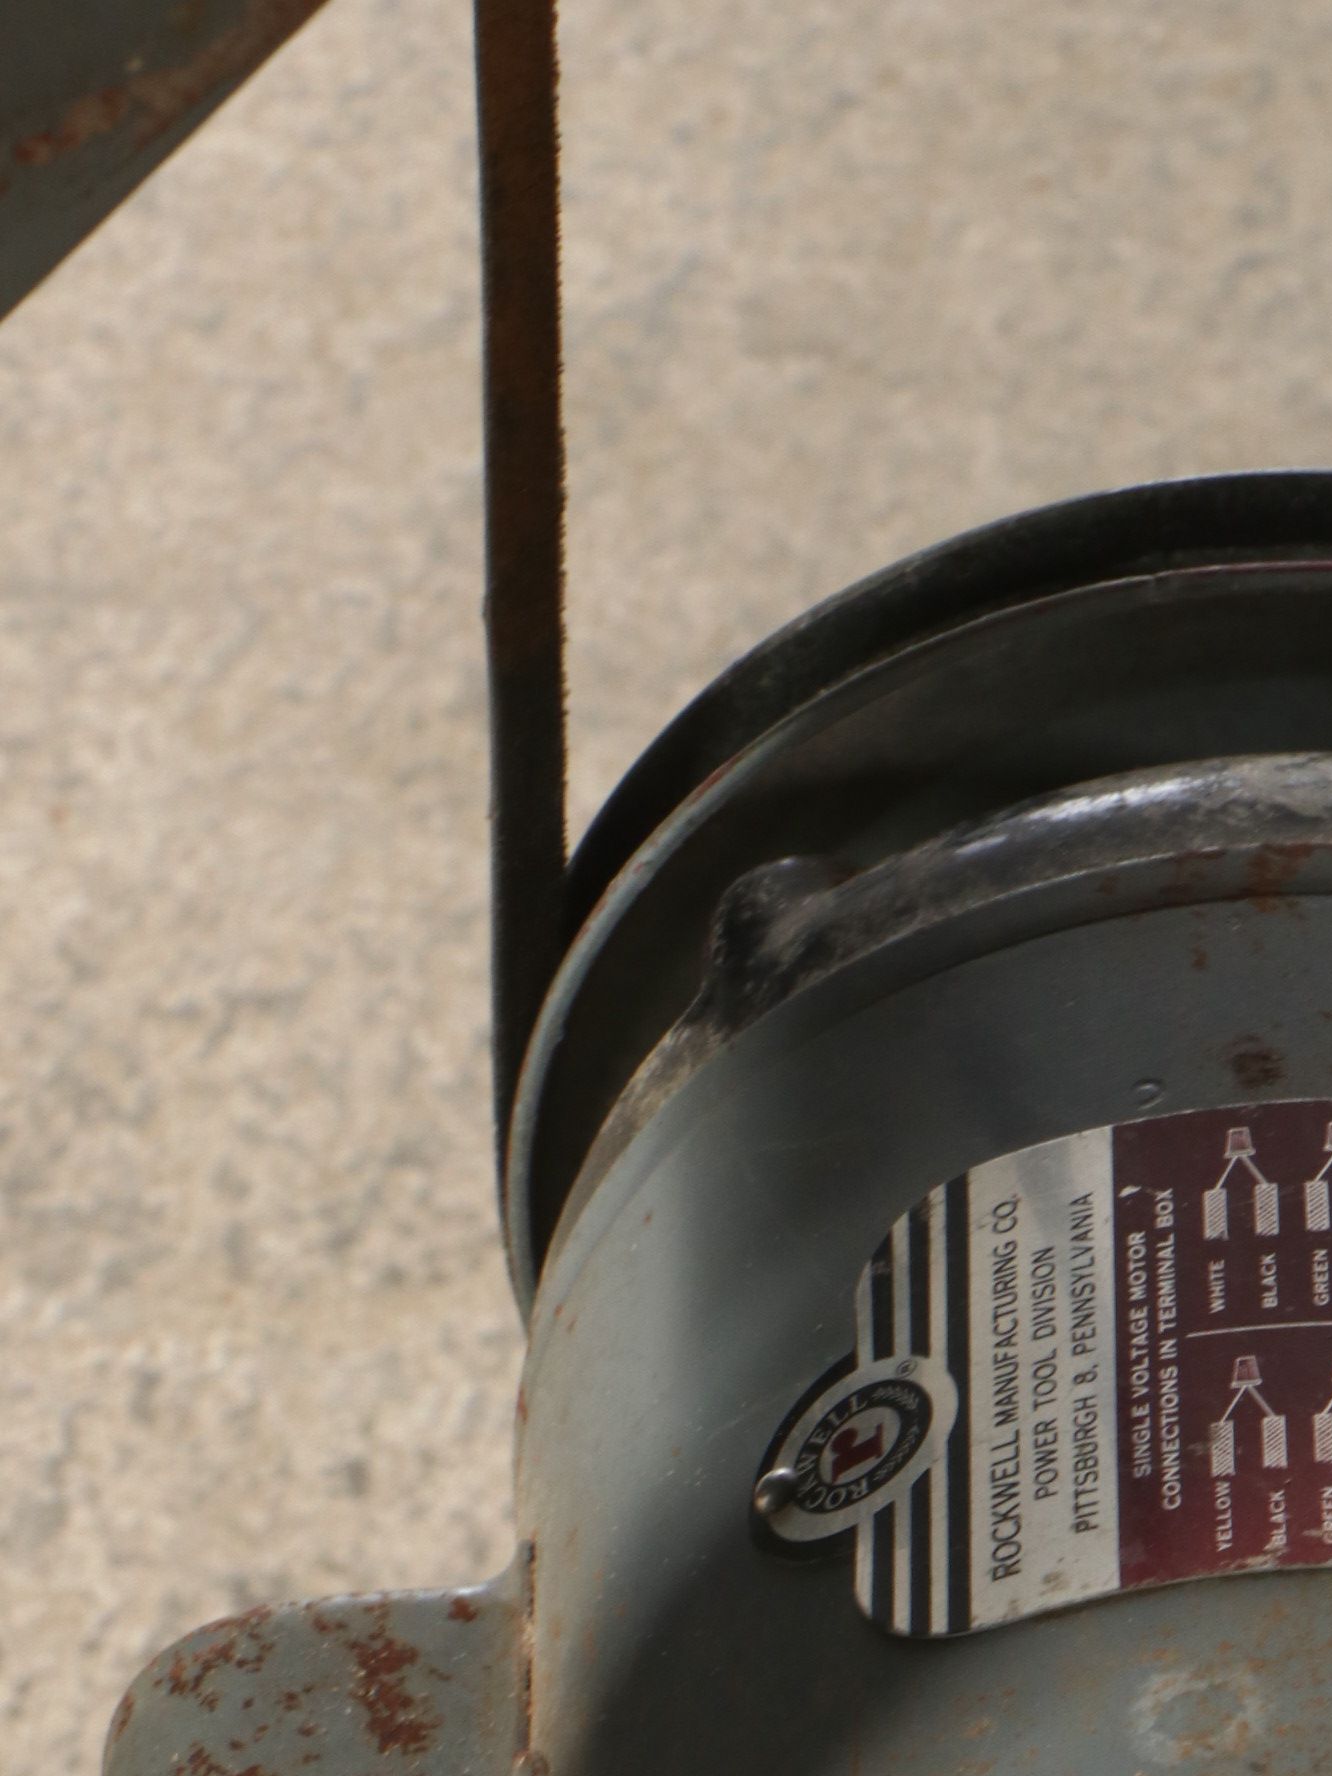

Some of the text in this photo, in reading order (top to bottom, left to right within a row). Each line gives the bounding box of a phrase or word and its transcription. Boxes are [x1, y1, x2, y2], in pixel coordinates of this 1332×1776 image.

[992, 1240, 1019, 1428] MANUFACTURING
[1069, 1192, 1096, 1356] PENNSYLVANIA
[1208, 1259, 1225, 1313] WHITE
[1260, 1252, 1278, 1308] BLACK
[1312, 1249, 1330, 1306] GREEN
[1030, 1246, 1058, 1500] POWER TOOL DIVISION
[1126, 1231, 1152, 1478] SINGLE VOLTAGE MOTOR
[1154, 1188, 1181, 1510] CONNECTIONS IN TERMINAL BOX
[796, 1393, 870, 1510] ROCKWELL
[989, 1430, 1021, 1583] ROCKWELL
[1074, 1395, 1099, 1534] PITTSBURGH
[1215, 1482, 1232, 1552] YELLOW
[1270, 1490, 1287, 1547] BLACK
